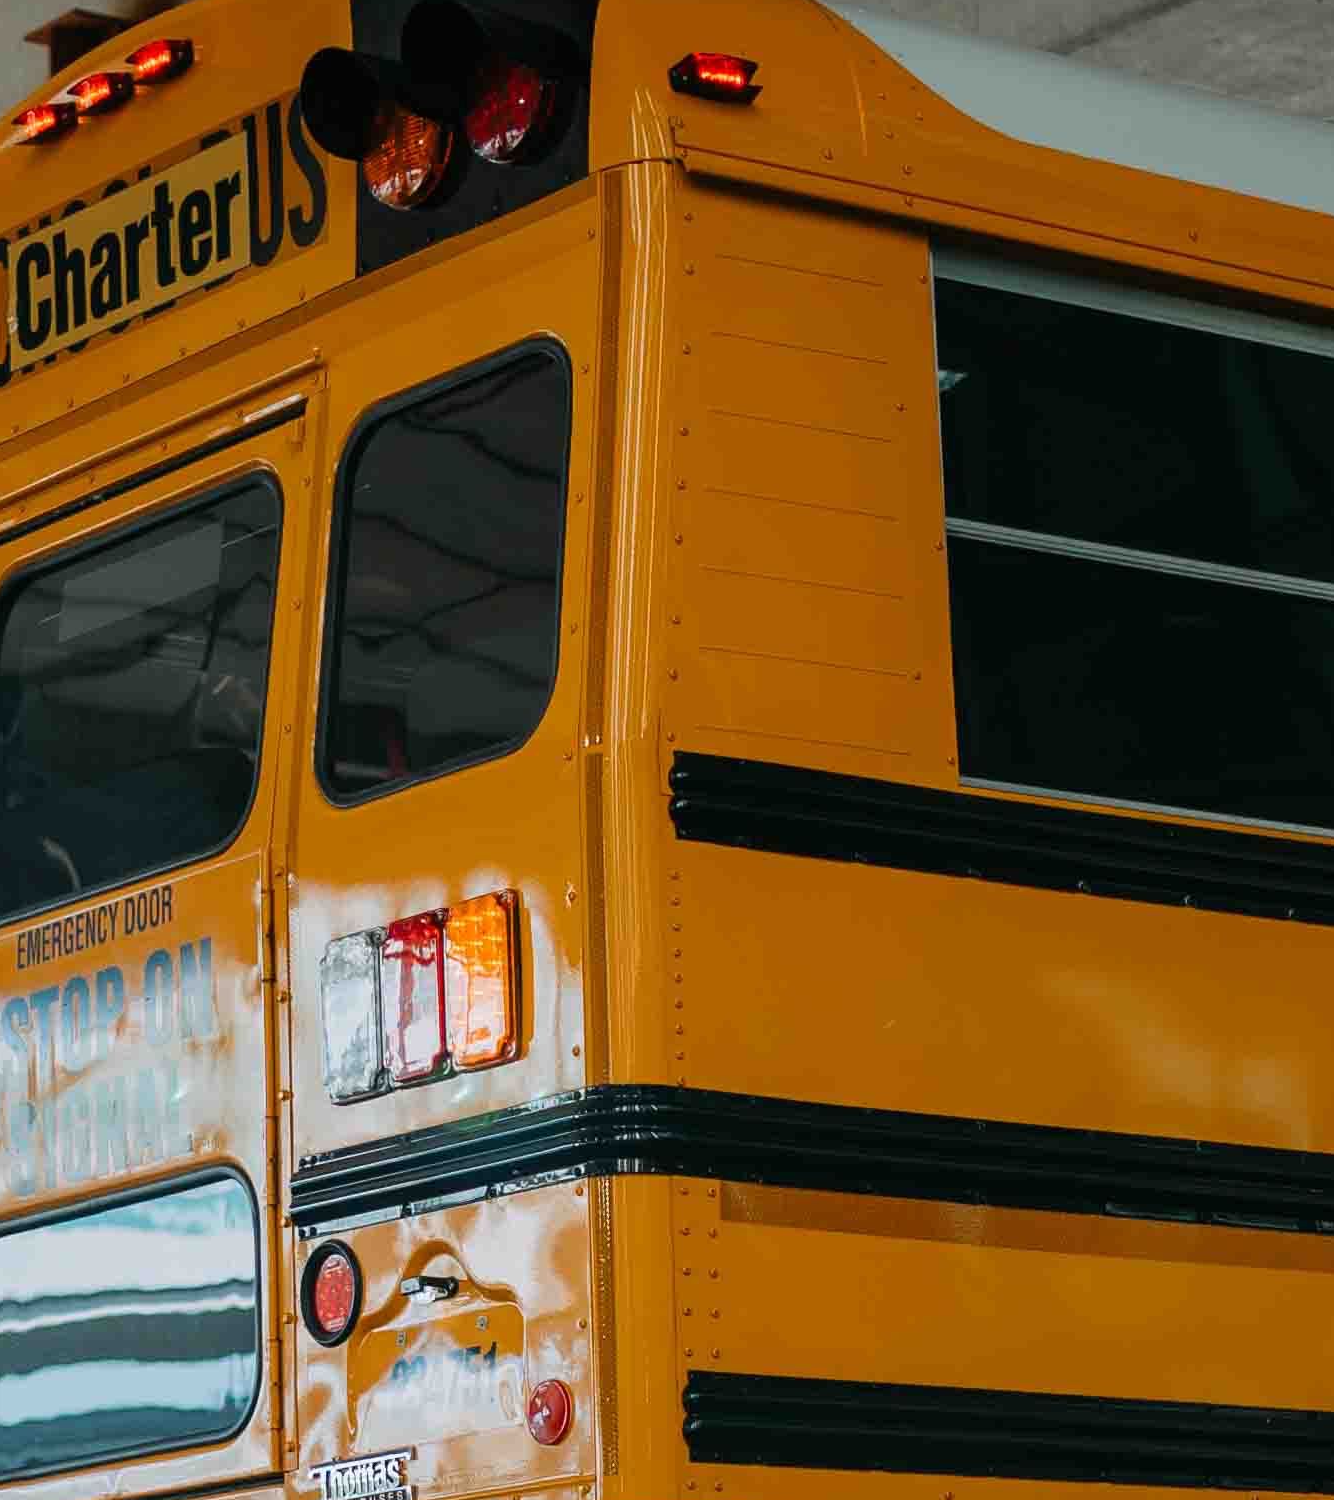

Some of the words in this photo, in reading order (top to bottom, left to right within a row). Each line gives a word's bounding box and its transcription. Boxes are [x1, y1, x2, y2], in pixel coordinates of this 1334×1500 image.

[15, 168, 243, 354] Charter
[16, 902, 120, 970] EMERGENCY
[122, 884, 174, 936] DOOR
[1, 965, 125, 1098] STOP
[142, 936, 213, 1045] ON
[308, 1452, 412, 1500] Thomas
